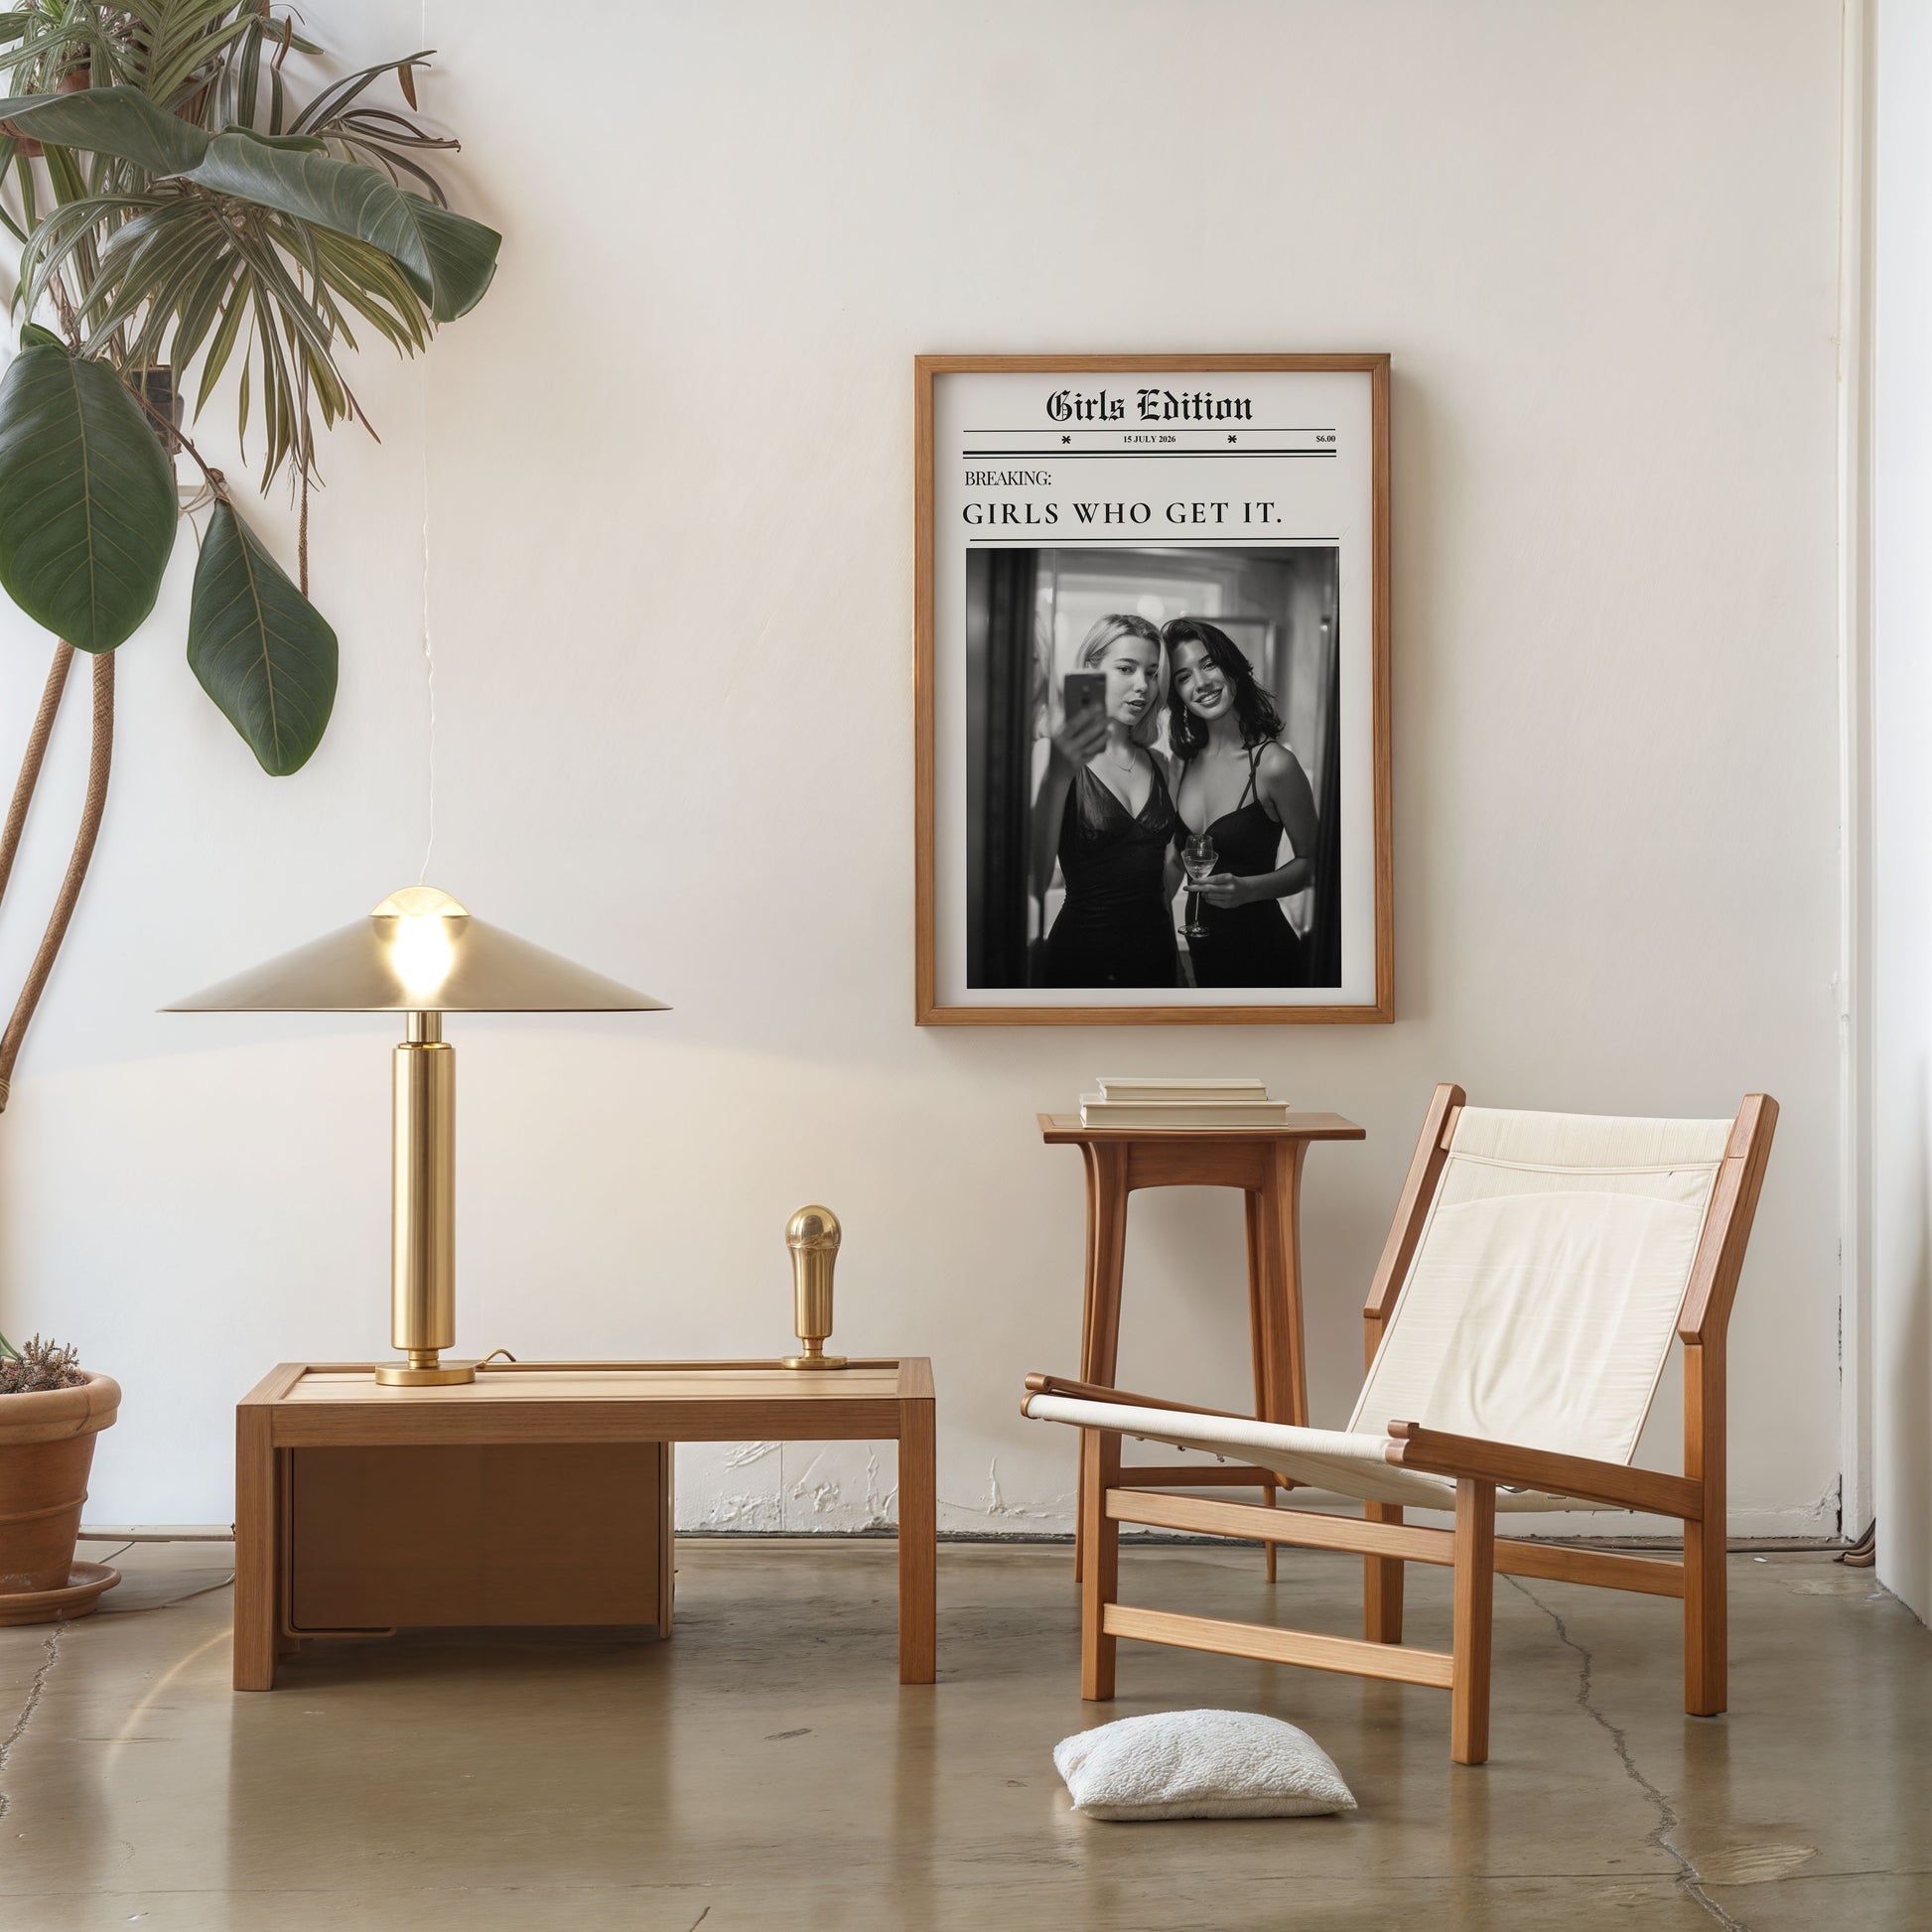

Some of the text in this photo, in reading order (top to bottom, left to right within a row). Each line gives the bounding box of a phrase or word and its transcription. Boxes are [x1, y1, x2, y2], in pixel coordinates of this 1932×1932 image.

[1045, 388, 1253, 422] Girls Edition
[964, 470, 1052, 486] BREAKING:
[962, 501, 1283, 525] GIRLS WHO GET IT.
